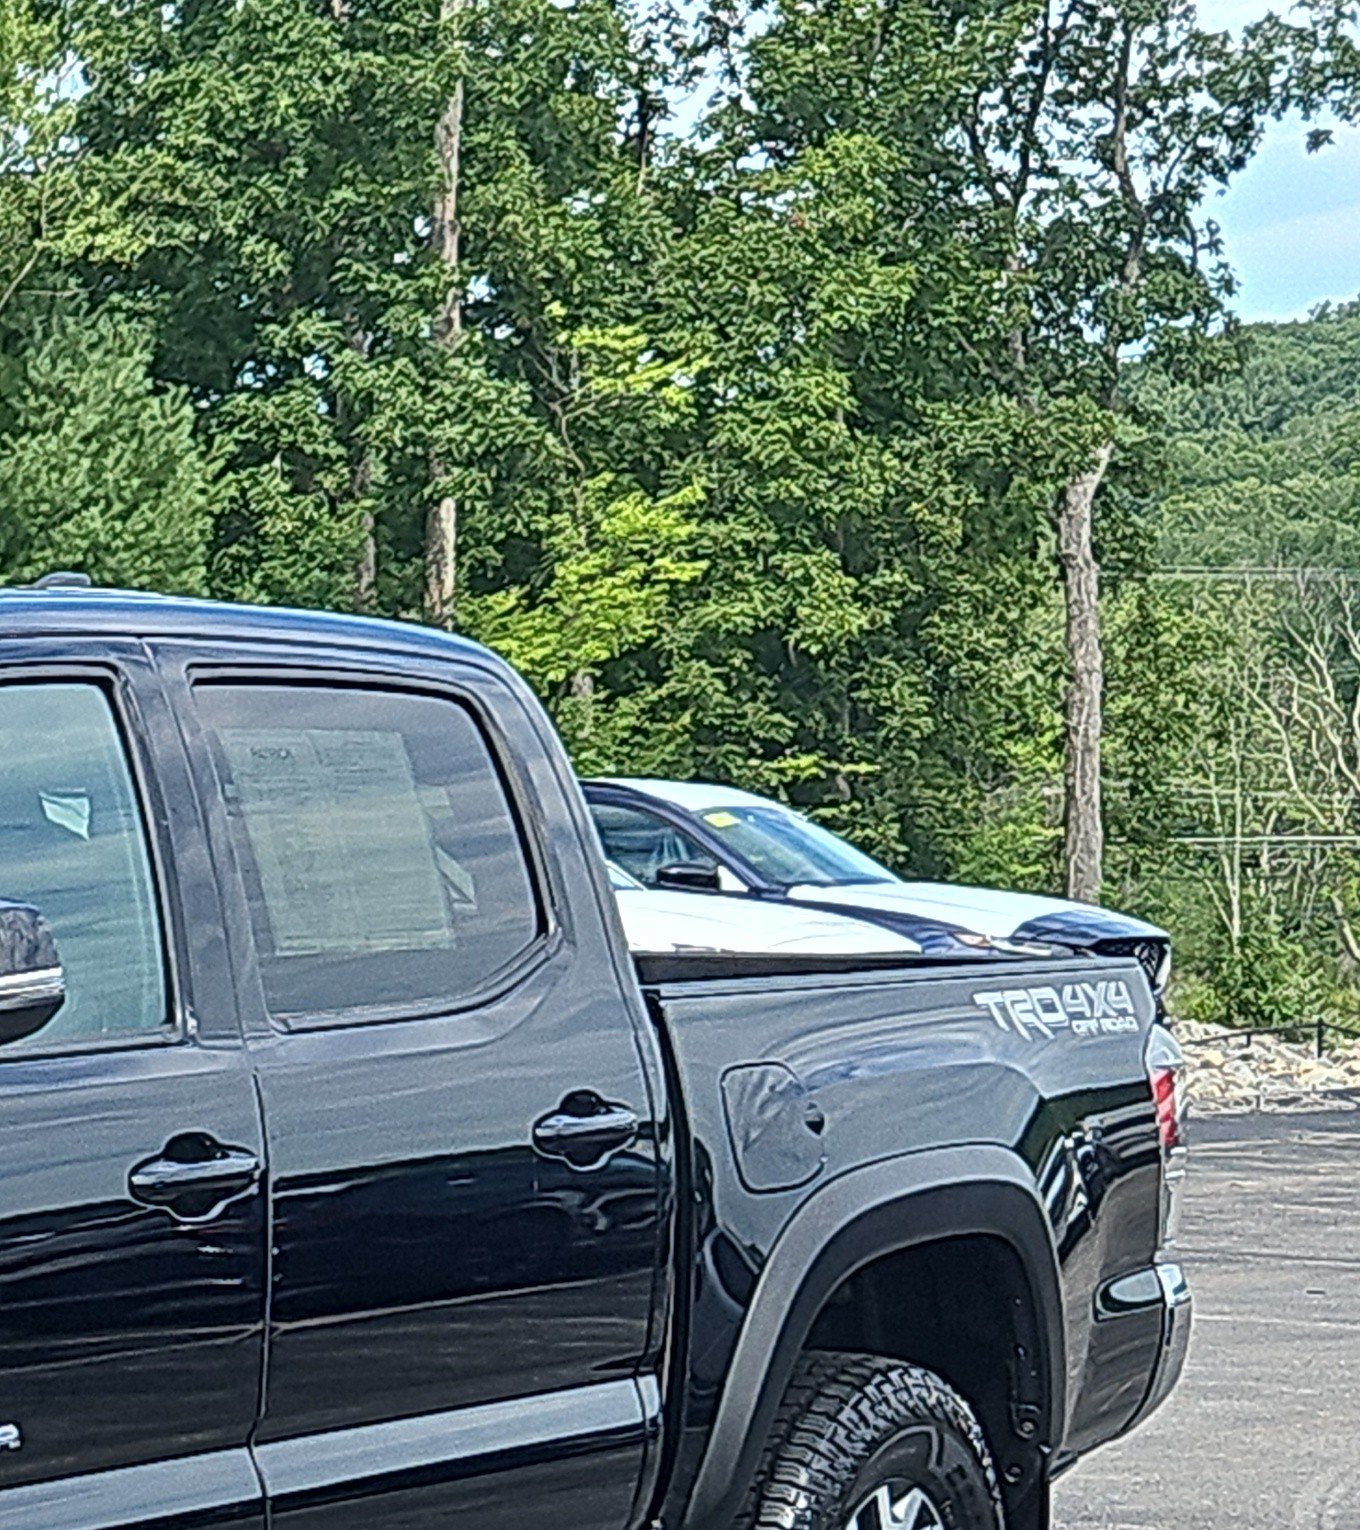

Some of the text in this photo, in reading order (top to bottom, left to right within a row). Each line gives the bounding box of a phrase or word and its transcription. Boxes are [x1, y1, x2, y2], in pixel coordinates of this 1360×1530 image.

[972, 985, 1069, 1041] TRD
[1071, 1016, 1140, 1036] OFF ROAD
